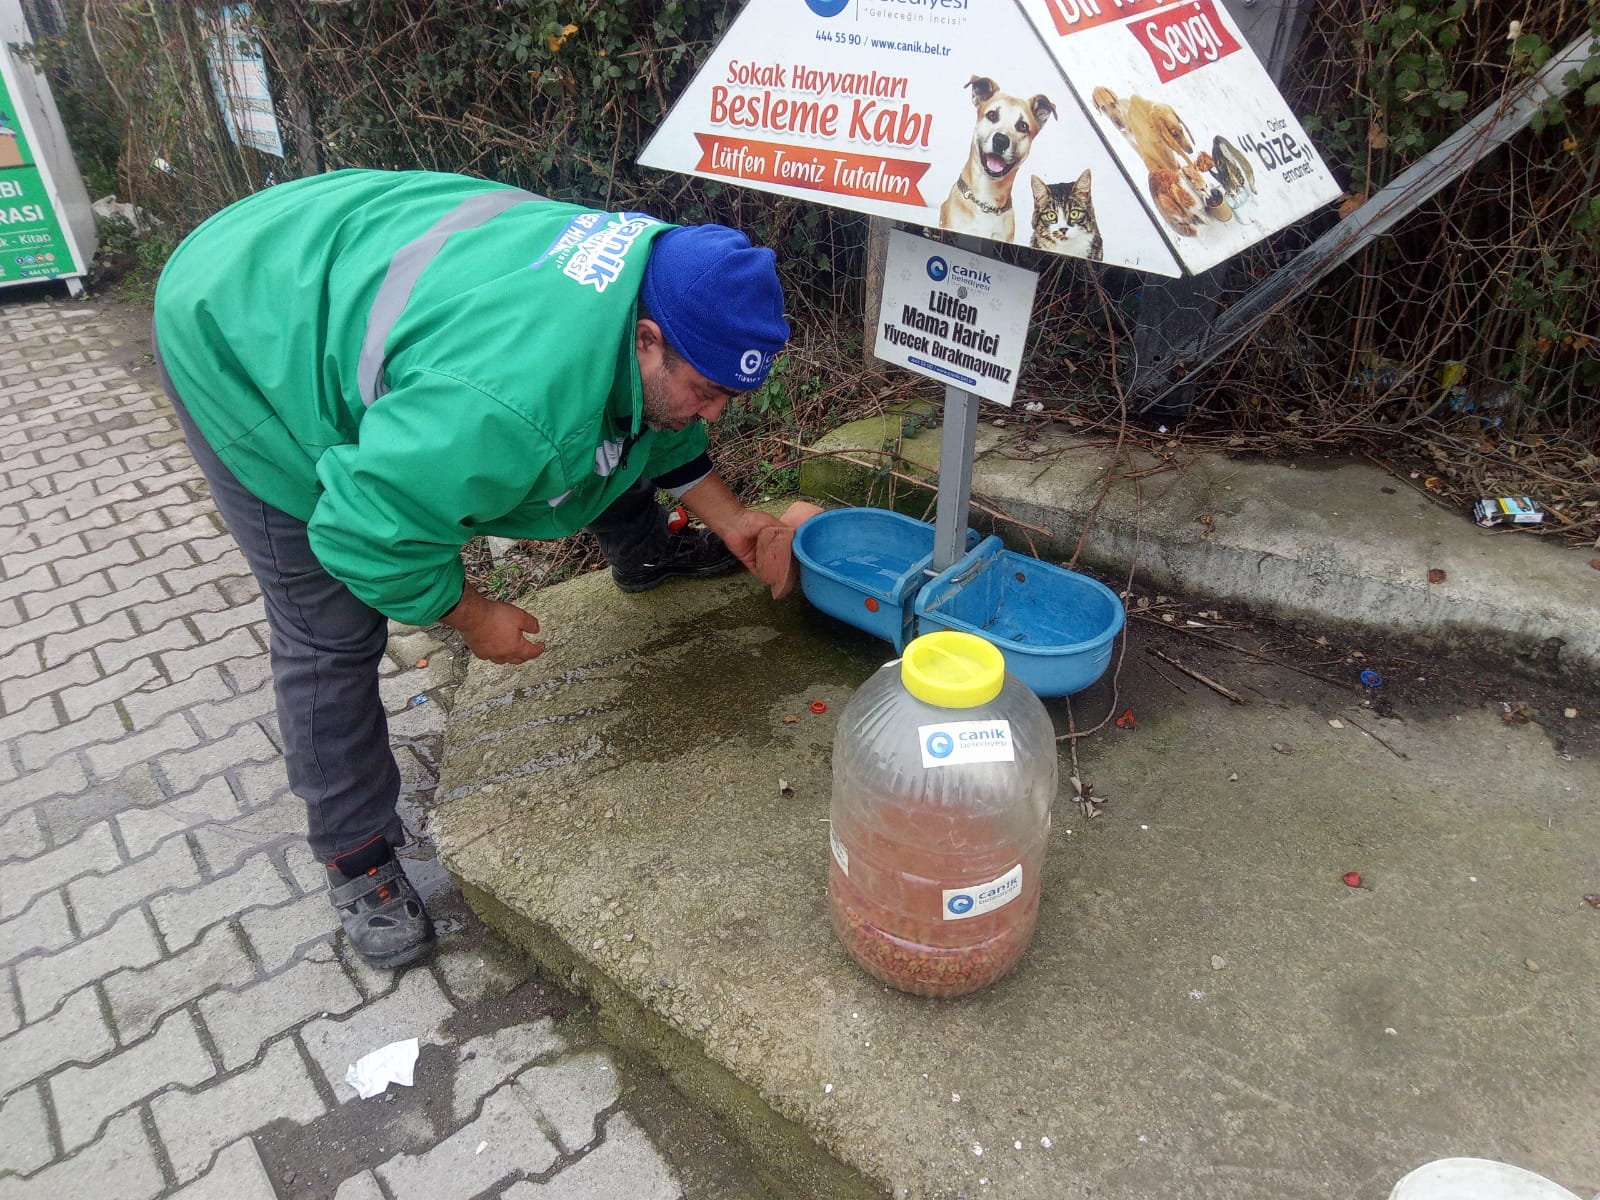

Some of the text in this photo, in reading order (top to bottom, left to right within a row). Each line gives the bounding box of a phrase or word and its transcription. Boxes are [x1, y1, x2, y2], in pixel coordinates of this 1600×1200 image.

[816, 30, 951, 56] 444 55 90 / www.canik.bel.tr
[1146, 2, 1223, 72] Sevgi
[727, 60, 908, 99] Sokak Hayvanları
[710, 86, 933, 147] Besleme Kabı
[711, 143, 910, 196] Lütfen Temiz Tutalım
[952, 265, 991, 284] canik
[928, 290, 978, 325] Lütfen
[902, 304, 1000, 357] Mama Harici
[884, 323, 929, 354] Yiyecek
[931, 341, 1012, 384] Bırakmayınız
[959, 728, 1006, 741] canik
[978, 877, 1018, 899] canik
